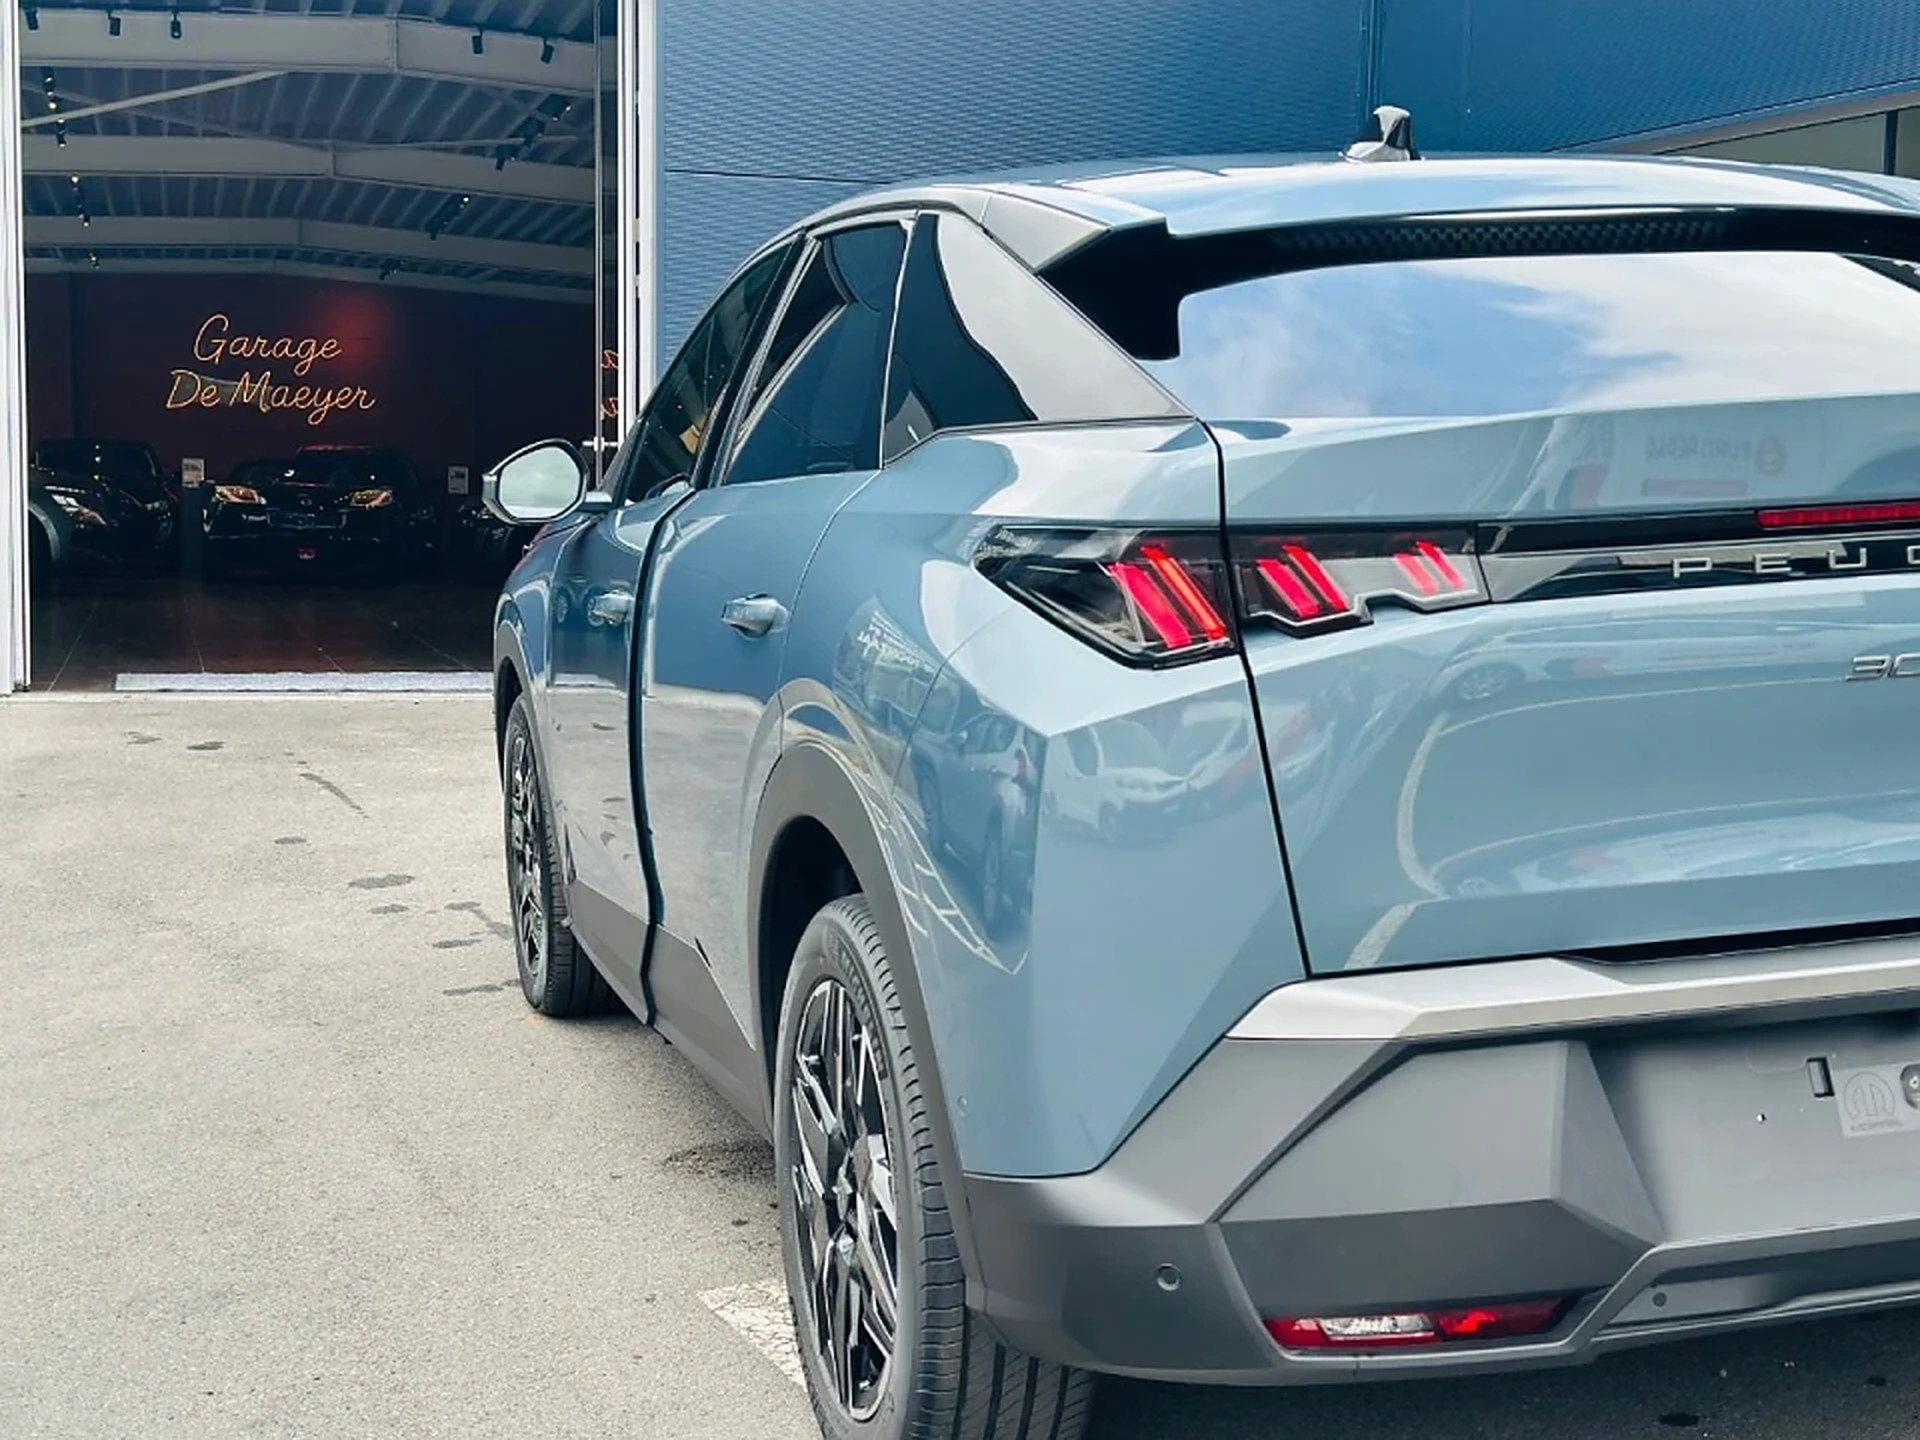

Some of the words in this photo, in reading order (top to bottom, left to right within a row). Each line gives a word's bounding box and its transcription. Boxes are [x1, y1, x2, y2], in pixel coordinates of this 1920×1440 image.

[194, 314, 342, 376] Garage
[166, 369, 220, 408] De
[229, 371, 376, 425] Maeyer
